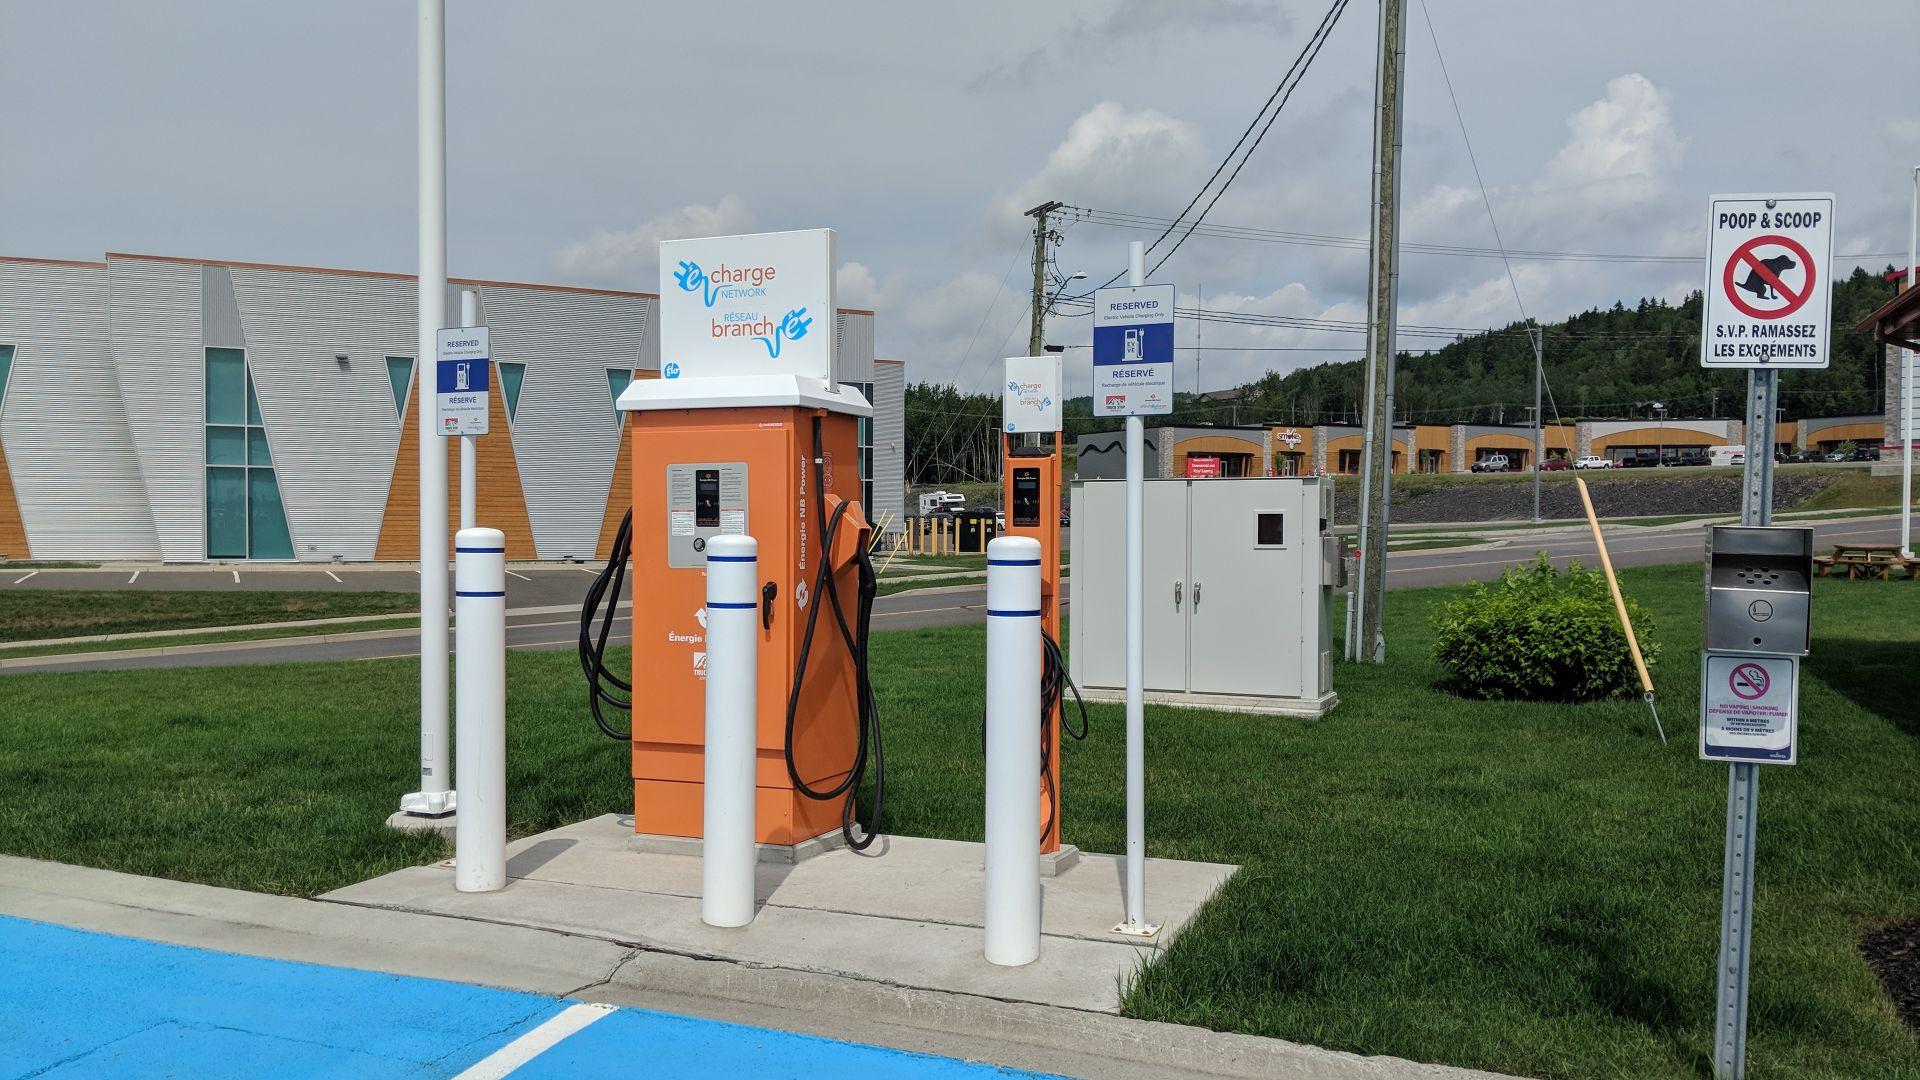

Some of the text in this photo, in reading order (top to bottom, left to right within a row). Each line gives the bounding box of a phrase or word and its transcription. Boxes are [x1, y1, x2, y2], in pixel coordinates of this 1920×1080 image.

[1719, 212, 1822, 229] POOP & SCOOP
[710, 263, 776, 286] charge
[721, 288, 767, 299] NETWORK
[1110, 300, 1159, 311] RESERVED
[724, 312, 758, 322] RÉSEAU
[1716, 324, 1816, 338] S.V.P. RAMASSEZ
[447, 340, 480, 348] RESERVED
[1714, 340, 1816, 358] LES EXCRÉMENTS
[1112, 368, 1155, 378] RÉSERVÉ
[800, 498, 806, 518] NB
[669, 630, 703, 644] Énergie
